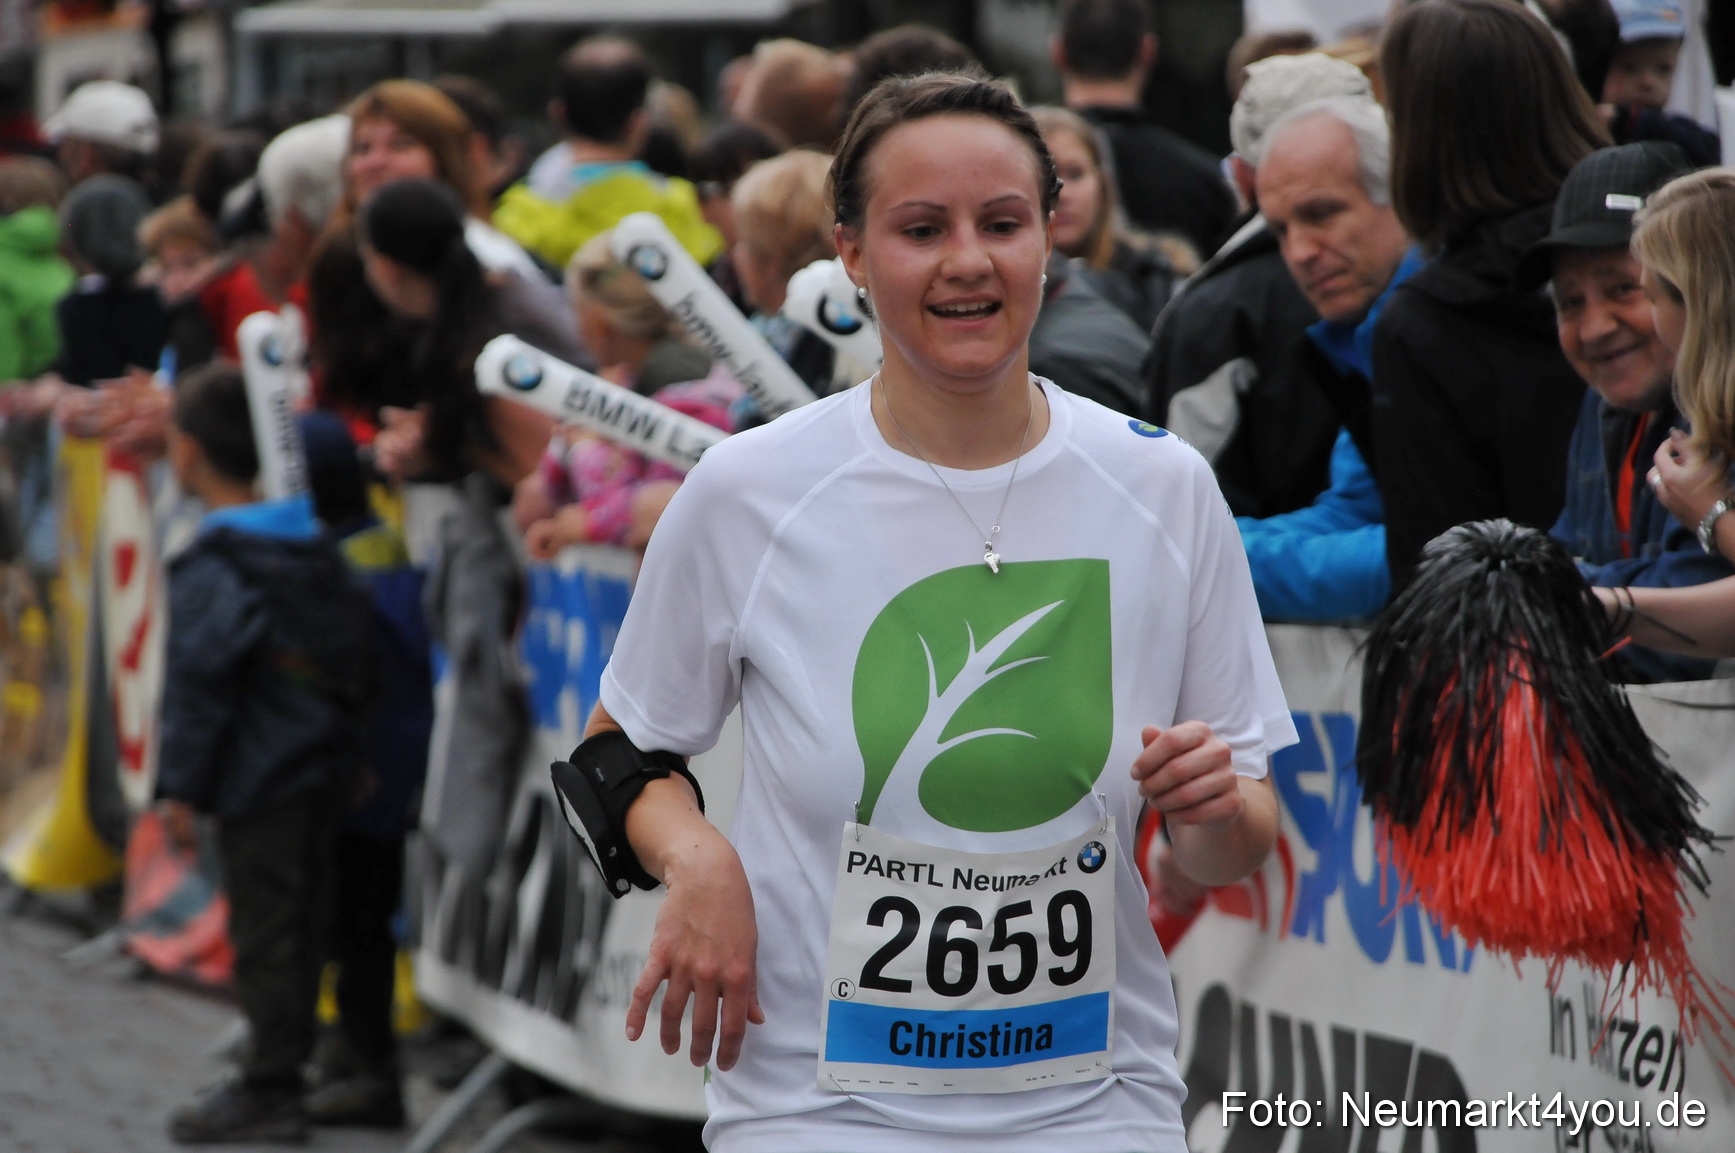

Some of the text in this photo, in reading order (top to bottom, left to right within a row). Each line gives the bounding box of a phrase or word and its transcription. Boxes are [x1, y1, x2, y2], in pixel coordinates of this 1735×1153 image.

[564, 377, 661, 441] BMW
[846, 850, 1067, 893] PARTL Neumakt
[858, 889, 1093, 998] 2659
[888, 1020, 1053, 1059] Christina
